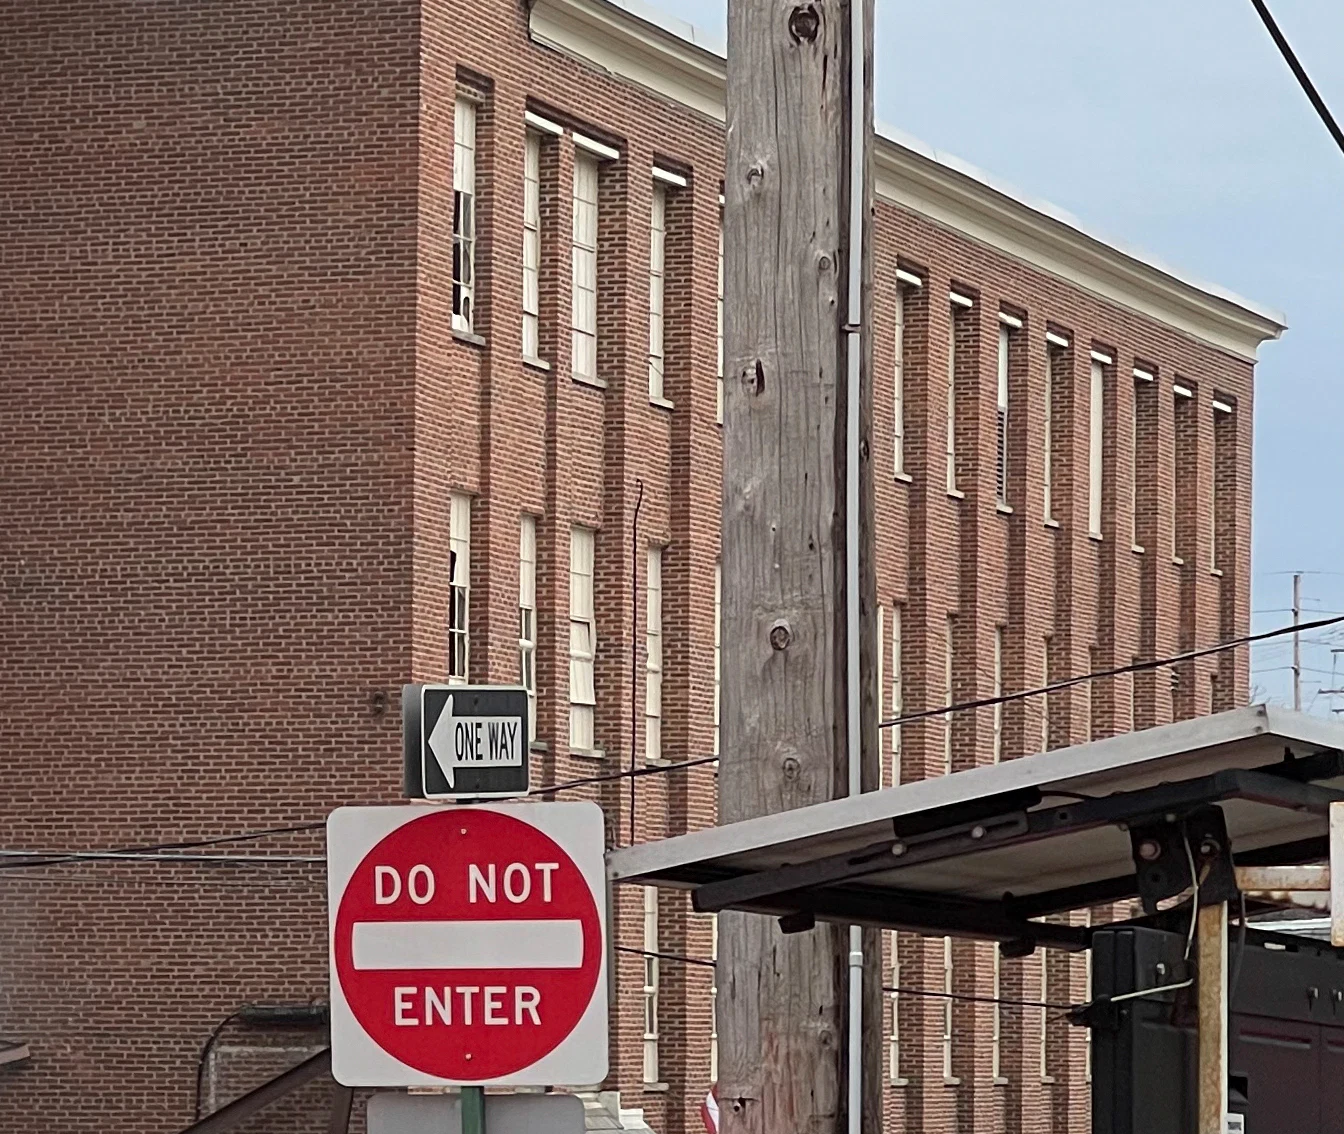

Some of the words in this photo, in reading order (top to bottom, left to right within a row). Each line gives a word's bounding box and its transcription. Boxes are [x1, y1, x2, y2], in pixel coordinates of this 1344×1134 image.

[454, 721, 483, 761] ONE
[488, 721, 518, 760] WAY
[374, 863, 435, 905] DO
[468, 862, 560, 904] NOT
[394, 986, 542, 1026] ENTER
